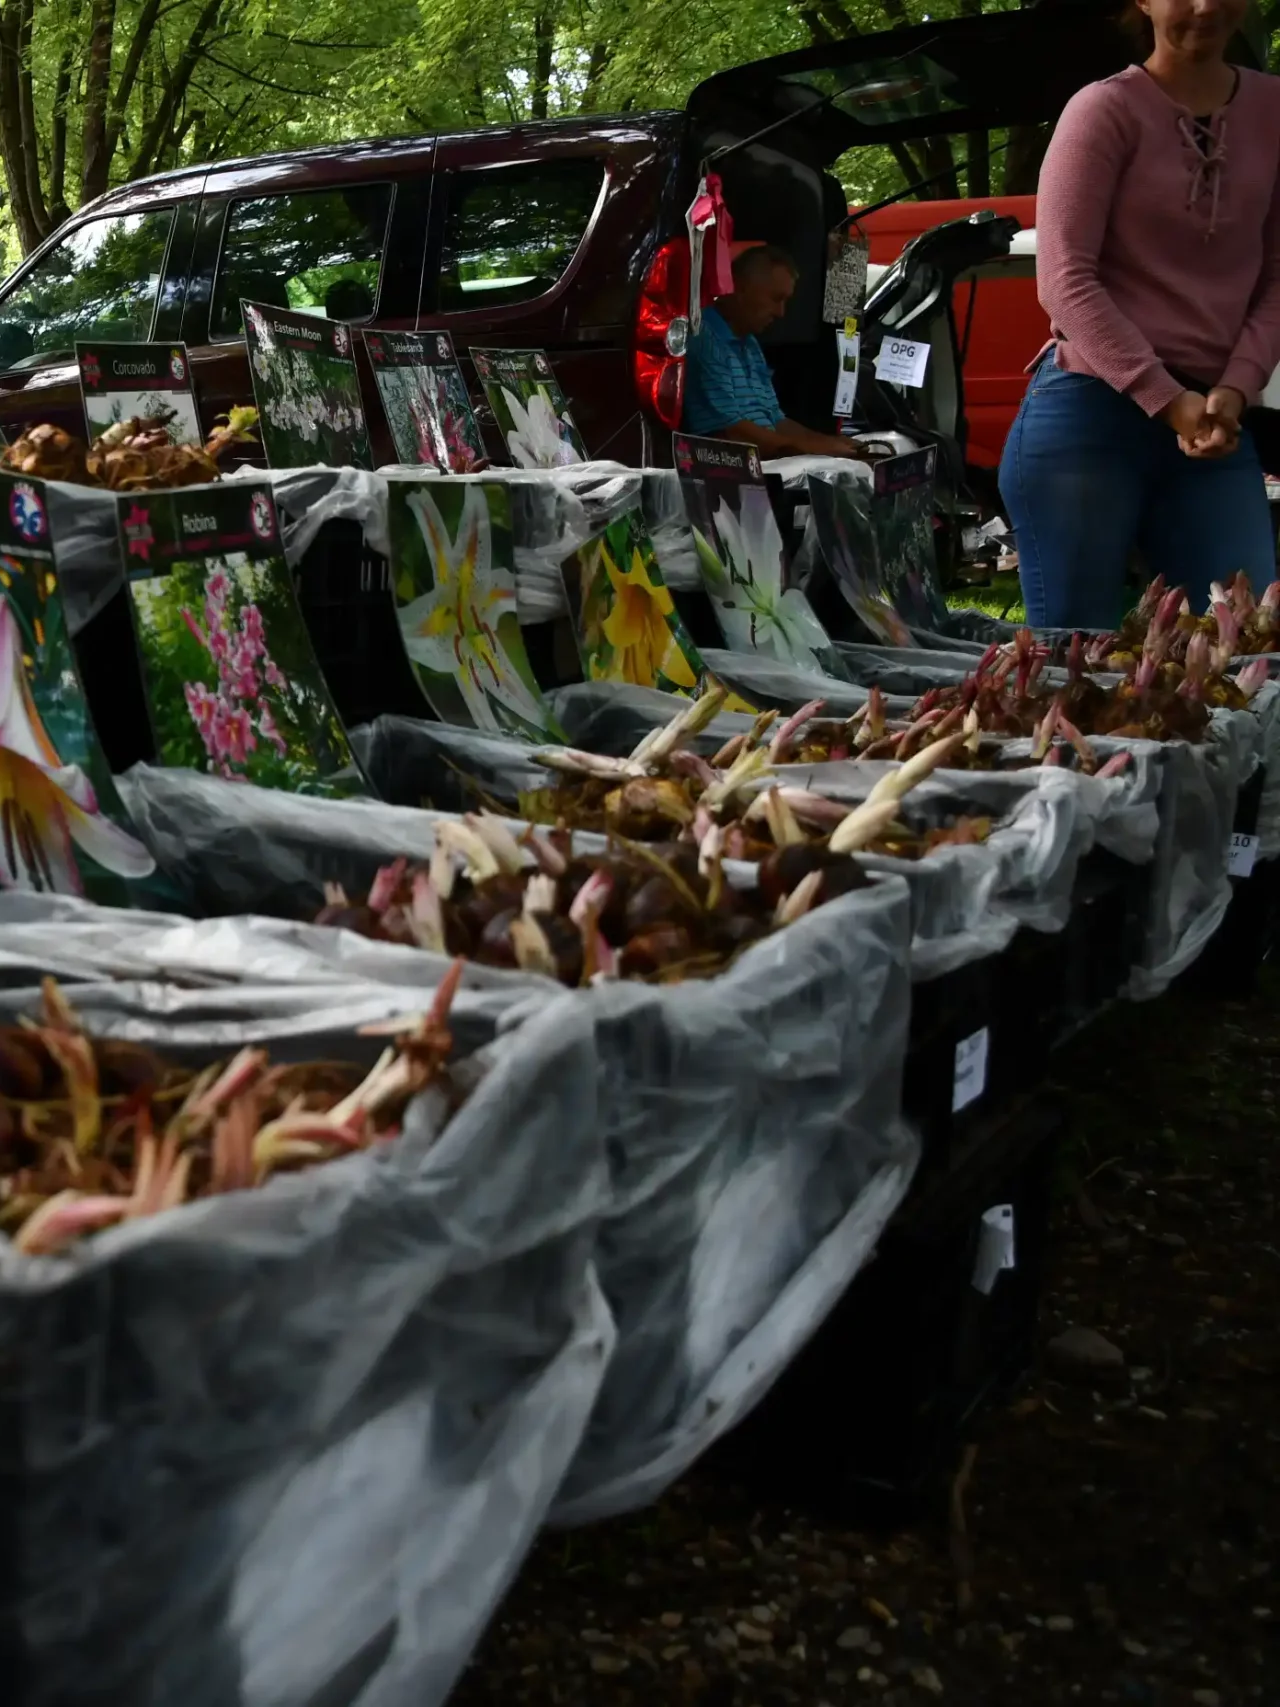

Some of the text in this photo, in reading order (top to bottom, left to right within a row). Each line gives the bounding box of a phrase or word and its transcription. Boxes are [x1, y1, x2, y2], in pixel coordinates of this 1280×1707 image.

[273, 320, 322, 341] Eastern Moon
[891, 342, 915, 358] OPG
[112, 358, 157, 375] Corcovado
[182, 513, 218, 534] Robina
